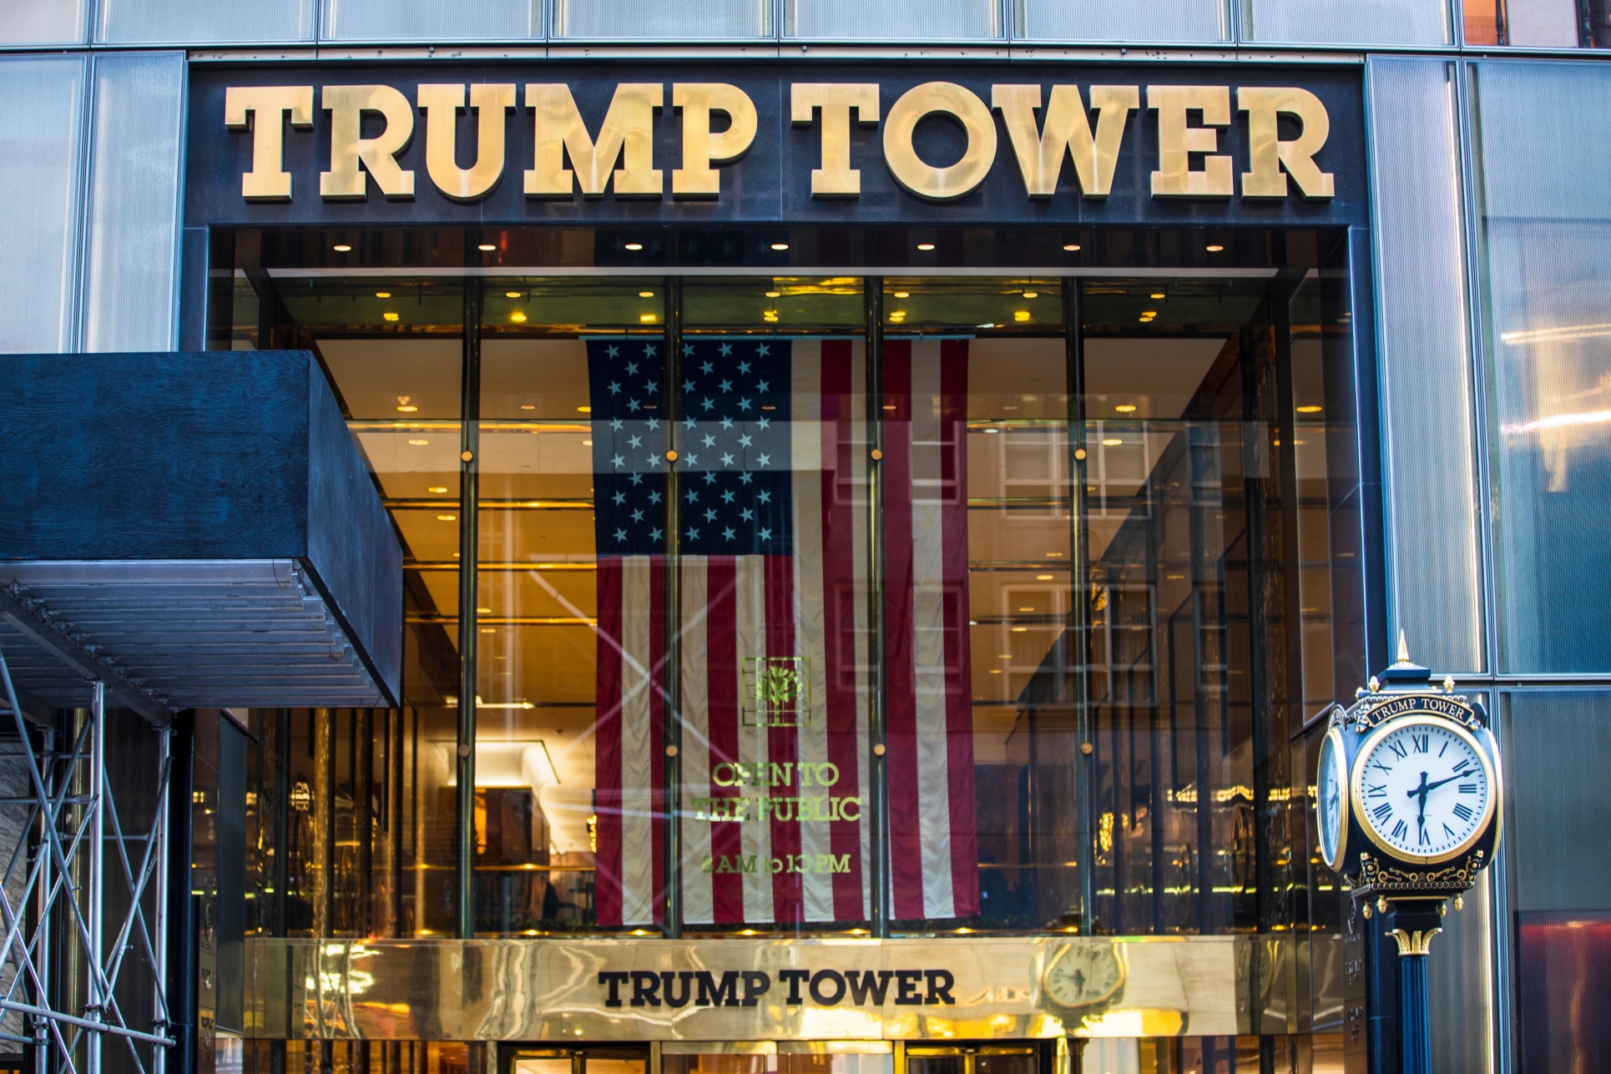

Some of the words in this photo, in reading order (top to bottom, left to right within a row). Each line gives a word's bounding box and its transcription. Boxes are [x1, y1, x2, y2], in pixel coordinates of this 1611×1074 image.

[225, 83, 758, 200] TRUMP
[791, 81, 1335, 199] TOWER
[1372, 699, 1416, 721] TRUMP
[1421, 698, 1465, 720] TOWER
[712, 762, 793, 787] OPEN
[797, 762, 840, 787] TO
[691, 797, 750, 822] THE
[756, 797, 862, 822] PUBLIC
[715, 854, 758, 874] AM
[762, 857, 784, 874] to
[786, 854, 812, 874] 10
[814, 854, 851, 874] PM
[598, 970, 771, 1008] TRUMP
[779, 968, 956, 1006] TOWER
